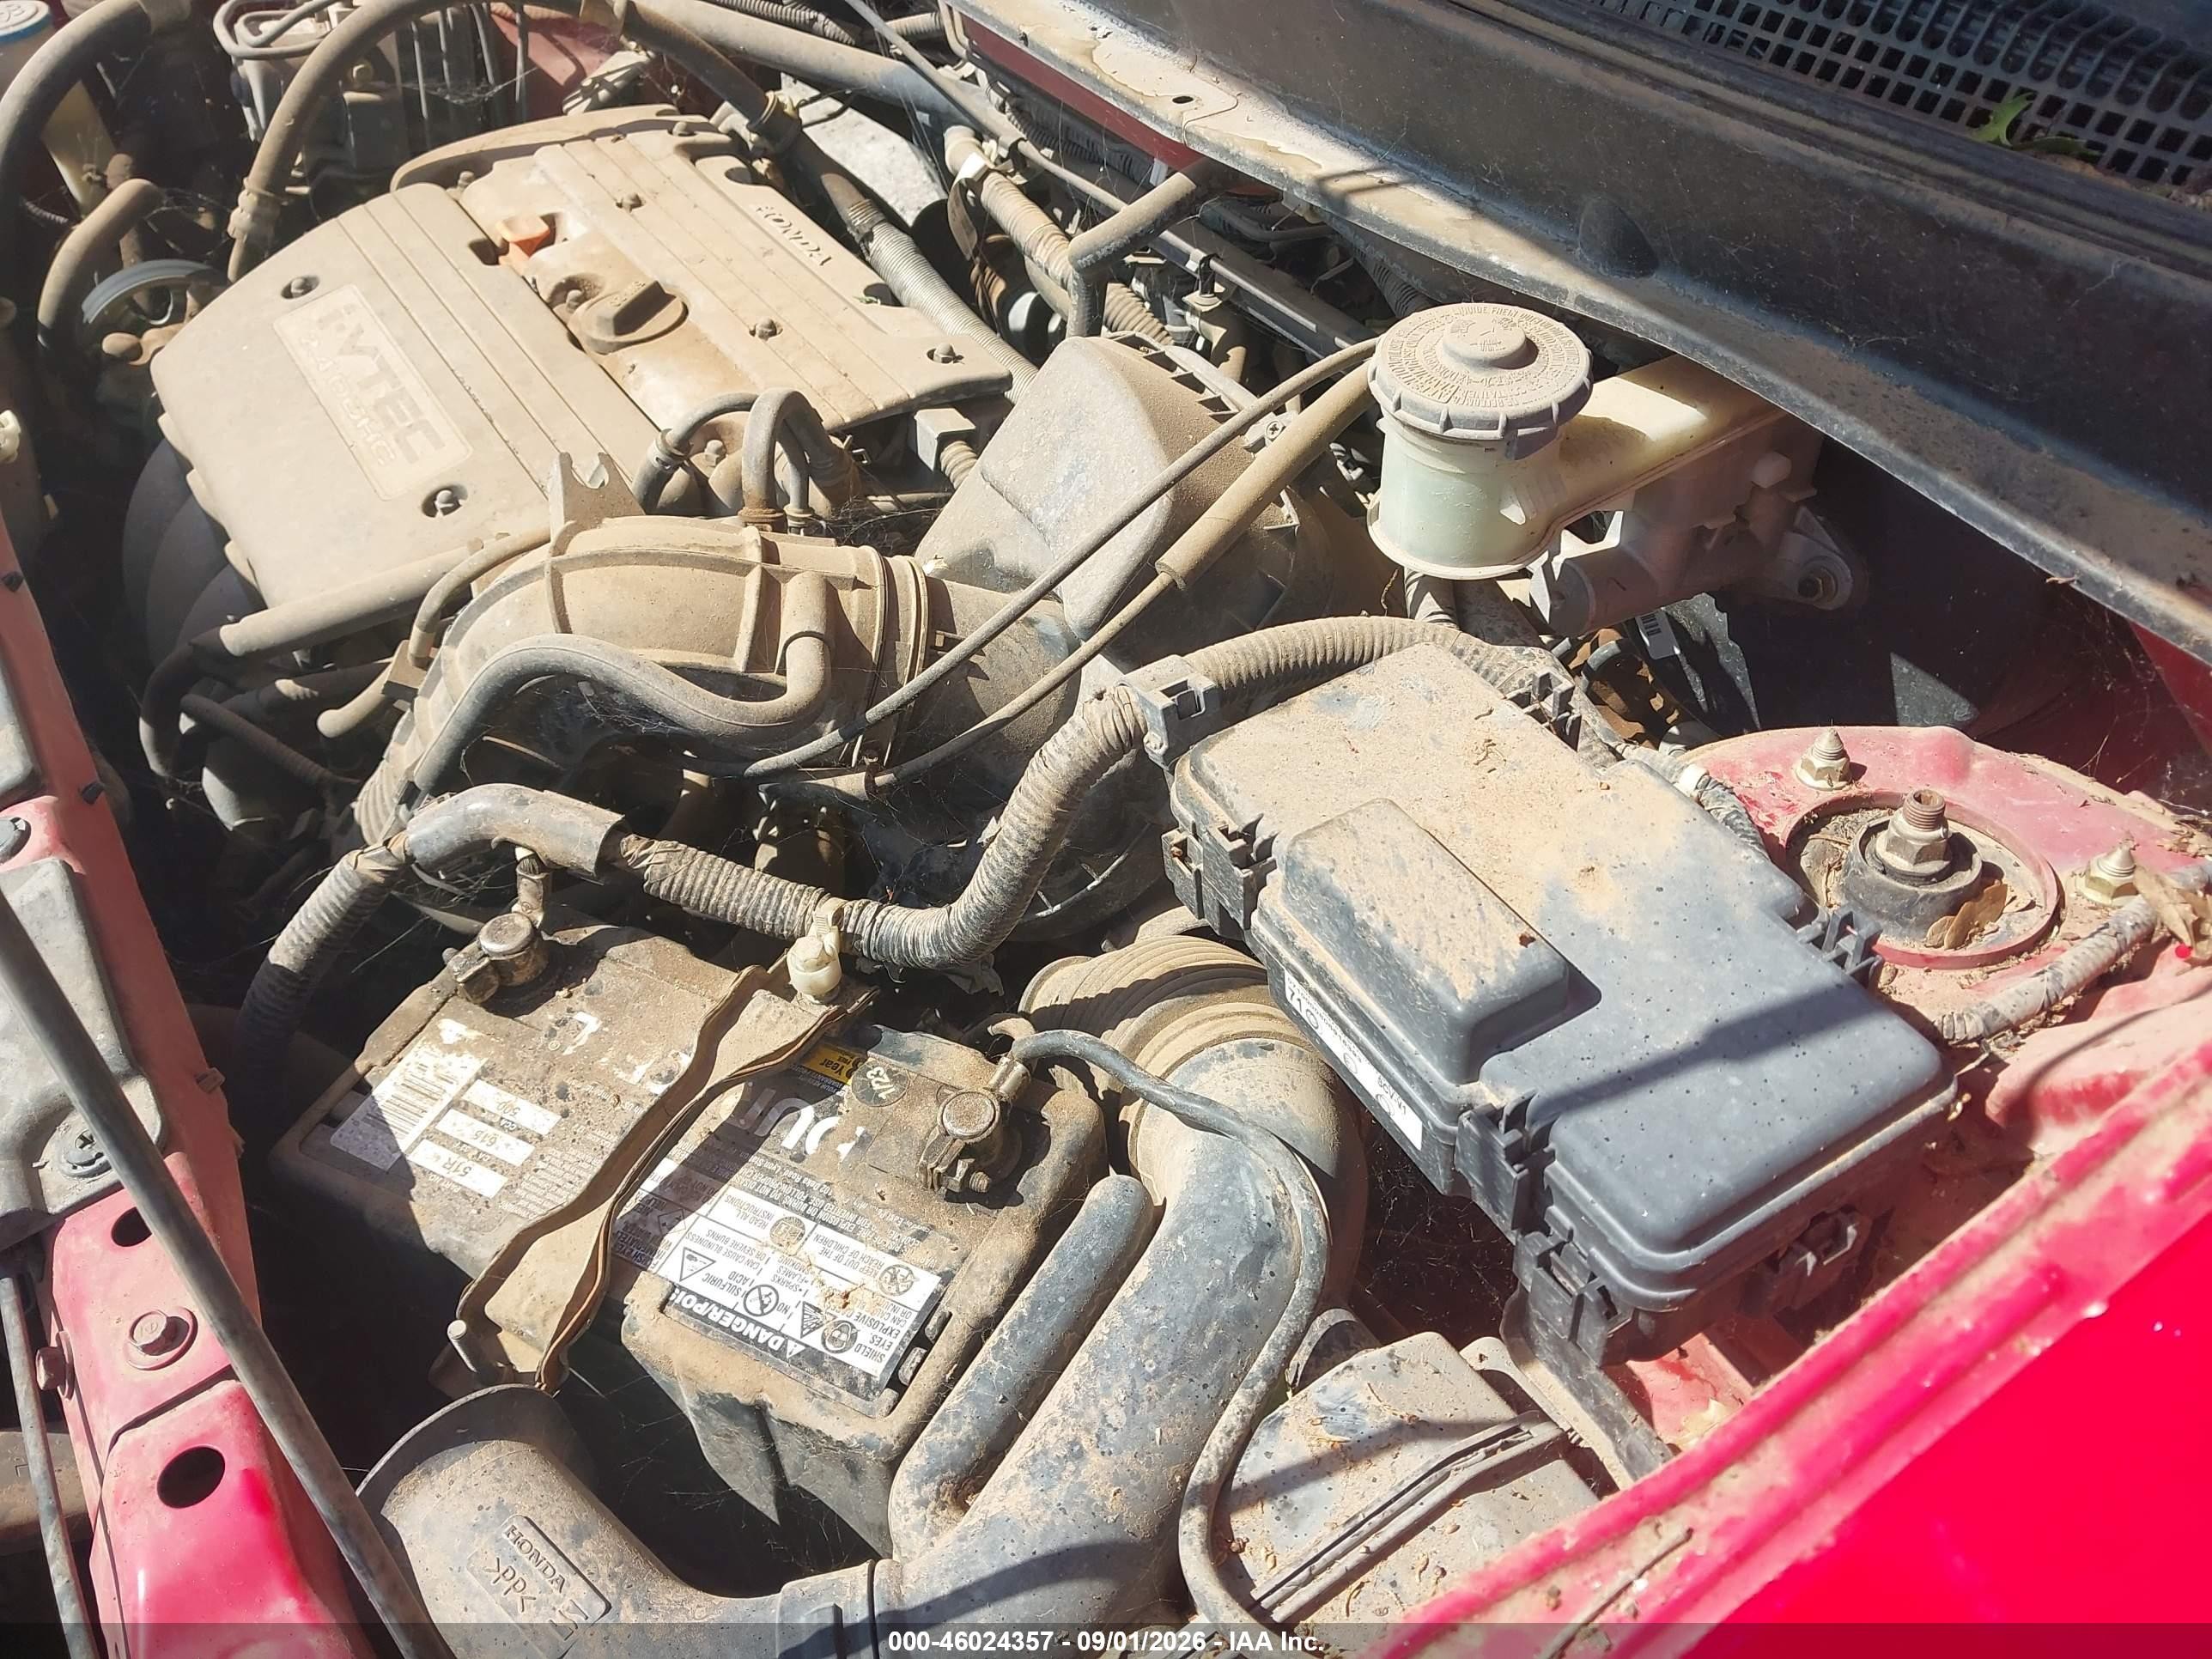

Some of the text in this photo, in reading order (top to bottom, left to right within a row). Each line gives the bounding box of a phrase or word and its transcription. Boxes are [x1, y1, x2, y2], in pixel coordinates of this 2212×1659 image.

[817, 1056, 847, 1076] Year
[866, 1066, 896, 1099] 1/23
[496, 1101, 521, 1117] 500
[498, 1118, 518, 1131] CCA
[470, 1128, 499, 1148] 615
[477, 1152, 490, 1162] CA
[441, 1157, 472, 1178] 51R
[761, 1158, 782, 1174] Lyon
[442, 1180, 463, 1193] PART
[751, 1170, 781, 1189] PROPER
[800, 1176, 821, 1191] Deka
[753, 1182, 771, 1195] NOT
[778, 1182, 808, 1201] FOLLOW
[818, 1183, 836, 1196] 102
[805, 1205, 819, 1216] OR
[822, 1200, 858, 1223] INVERTED
[747, 1214, 769, 1230] READ
[816, 1209, 856, 1232] EXPLOSION
[854, 1214, 872, 1229] FOR
[683, 1231, 724, 1254] BLINDNESS
[727, 1238, 756, 1256] SEVERE
[720, 1248, 746, 1264] CAUSE
[753, 1249, 767, 1261] OR
[847, 1247, 861, 1259] OF
[858, 1251, 885, 1269] REACH
[743, 1257, 761, 1270] CAN
[817, 1246, 880, 1279] KEEP OUT OF THE
[700, 1271, 744, 1297] SULFURIC
[726, 1269, 750, 1285] ACID
[775, 1301, 791, 1314] NO
[898, 1308, 913, 1319] OR
[851, 1311, 901, 1339] EXPLOSIVE
[889, 1314, 907, 1328] CAN
[864, 1331, 894, 1351] EYES.
[852, 1341, 887, 1363] SHIELD
[503, 1525, 566, 1595] HONDA
